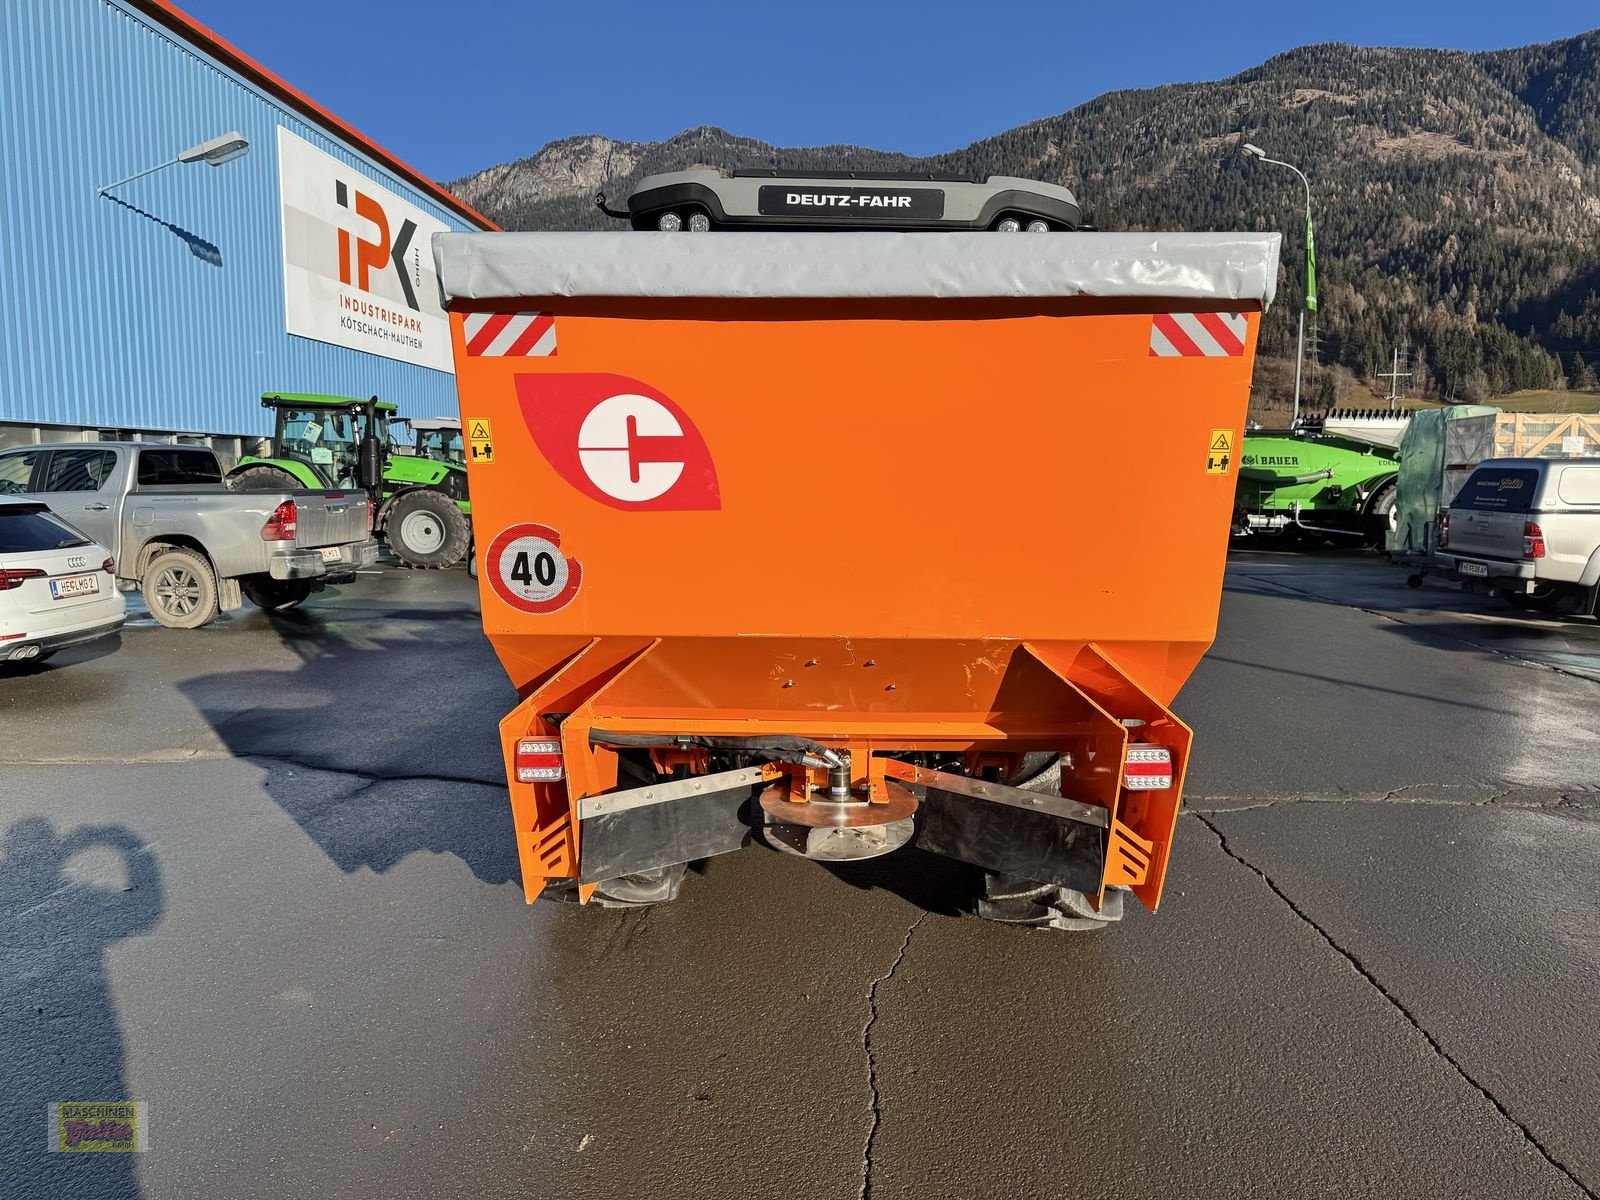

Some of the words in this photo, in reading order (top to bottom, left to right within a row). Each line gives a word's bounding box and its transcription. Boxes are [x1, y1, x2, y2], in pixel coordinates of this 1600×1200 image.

[786, 193, 912, 208] DEUTZ-FAHR
[339, 294, 422, 333] INDUSTRIEPARK
[340, 316, 423, 349] KÖTSCHACH-MAUTHEN
[1261, 456, 1299, 466] BAUER
[511, 551, 556, 587] 40
[61, 580, 71, 593] HE
